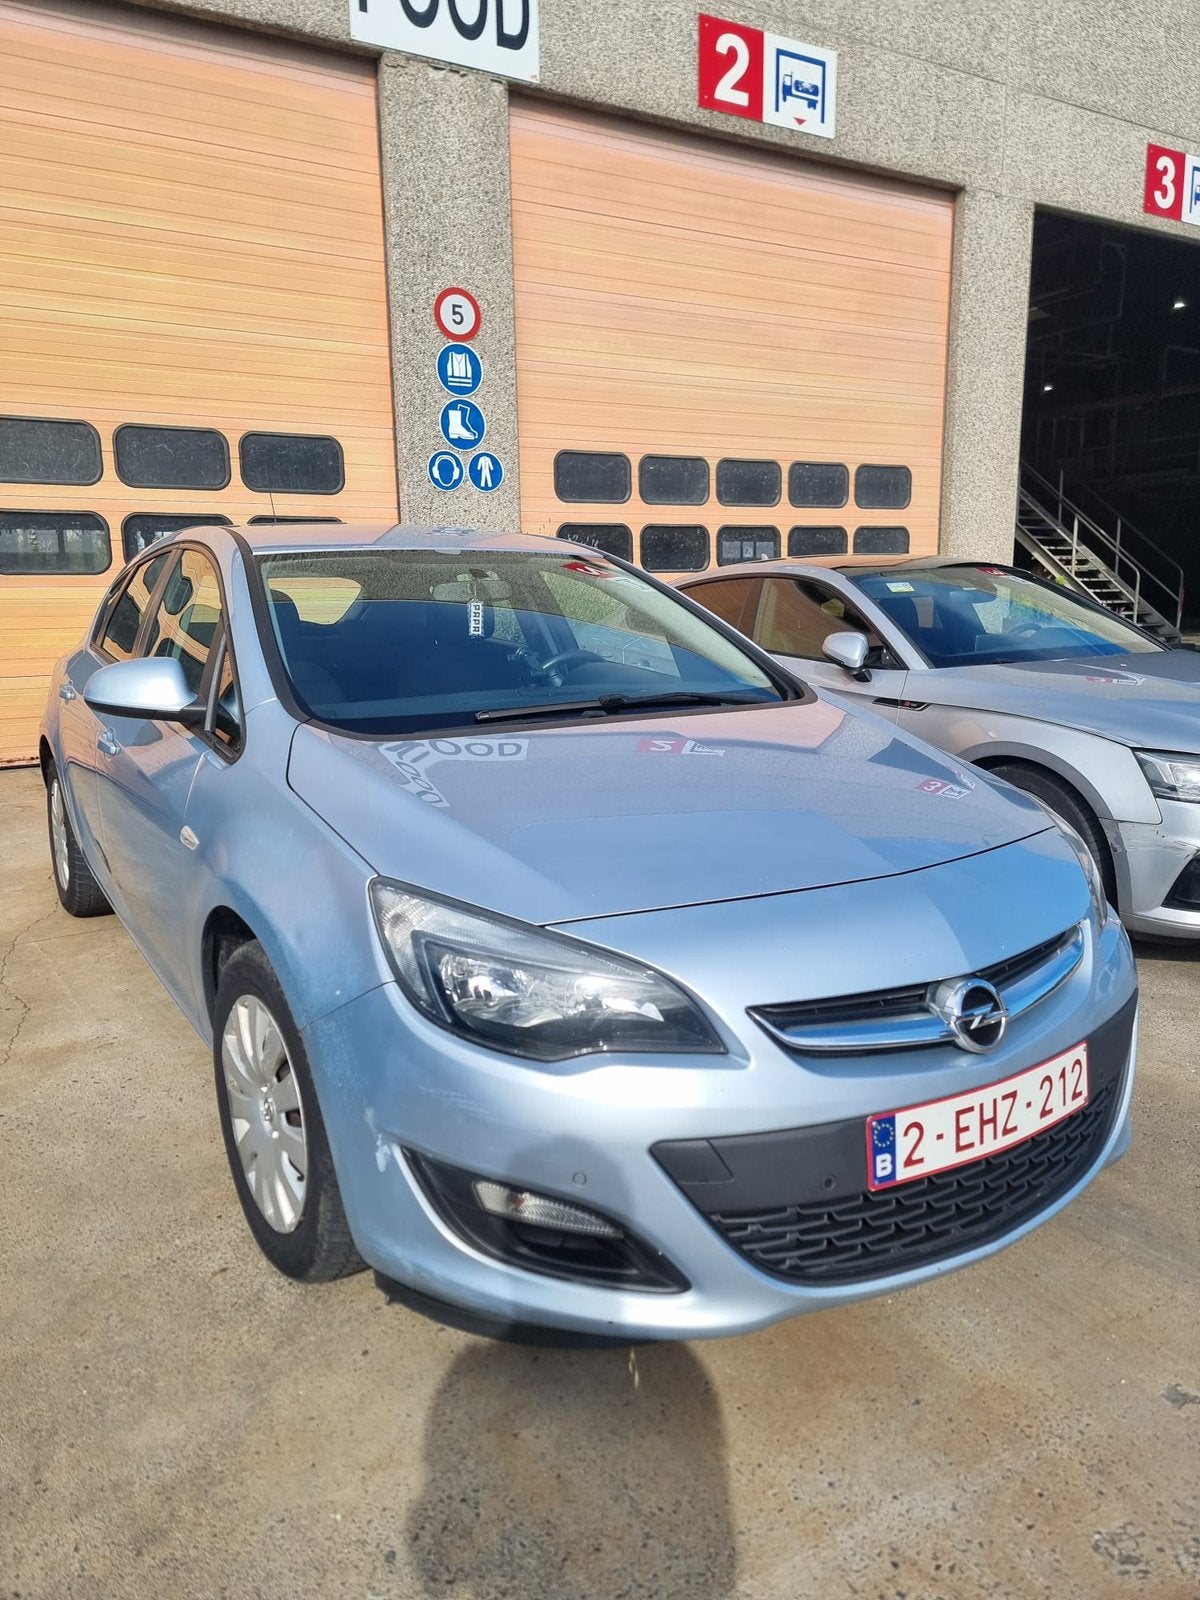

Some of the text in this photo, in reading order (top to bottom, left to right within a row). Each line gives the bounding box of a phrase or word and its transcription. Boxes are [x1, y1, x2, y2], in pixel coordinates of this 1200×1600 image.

[714, 33, 750, 107] 2
[1153, 155, 1176, 209] 3
[452, 304, 464, 325] 5
[903, 1058, 1083, 1168] 2-EHZ-212
[875, 1153, 893, 1178] B
